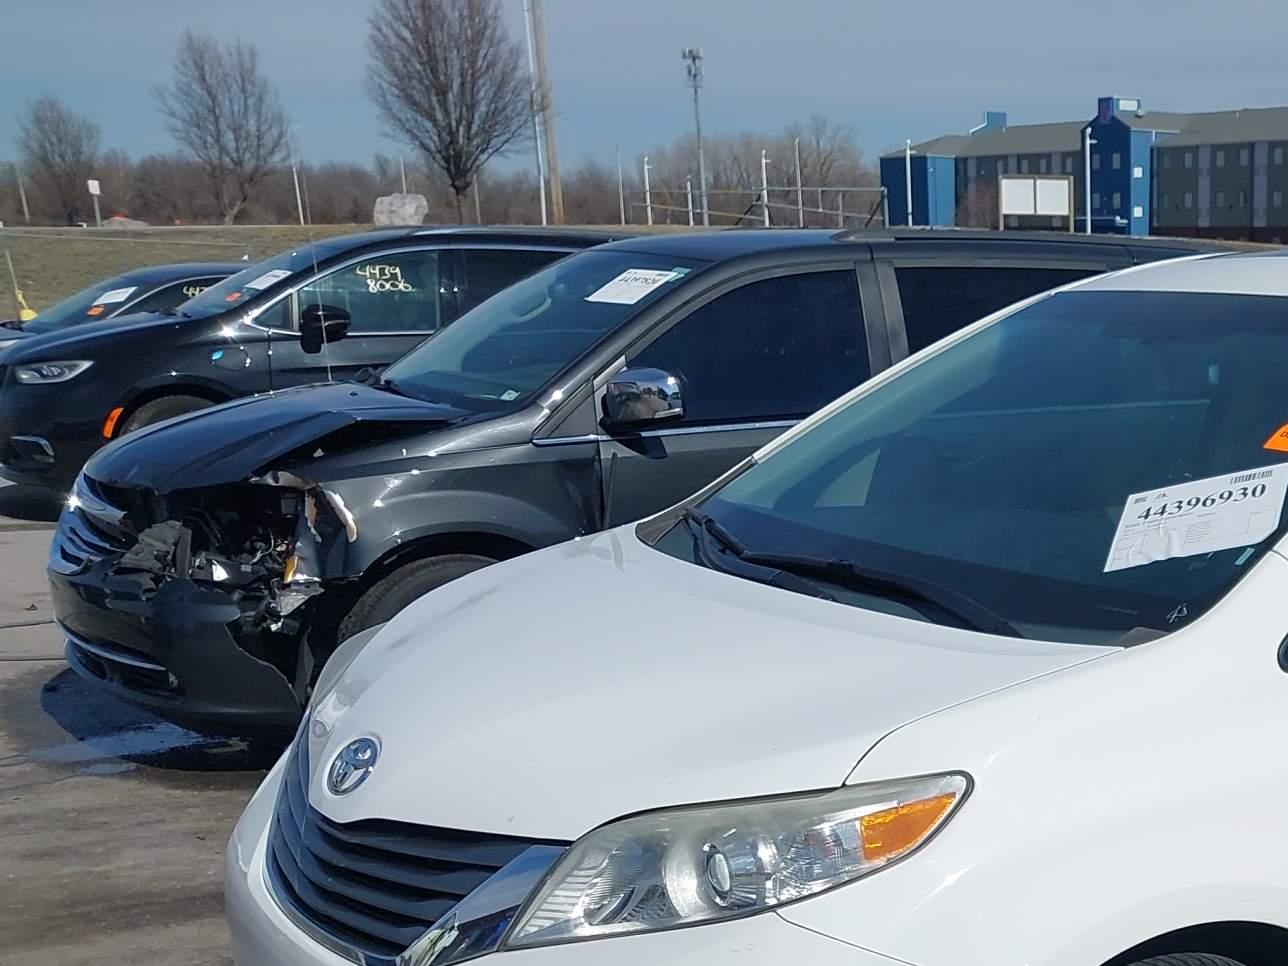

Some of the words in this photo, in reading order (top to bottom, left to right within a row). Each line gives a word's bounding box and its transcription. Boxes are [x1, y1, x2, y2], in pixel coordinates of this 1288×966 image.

[355, 264, 402, 281] 4439
[367, 278, 413, 293] 8006
[1137, 483, 1267, 521] 44396930
